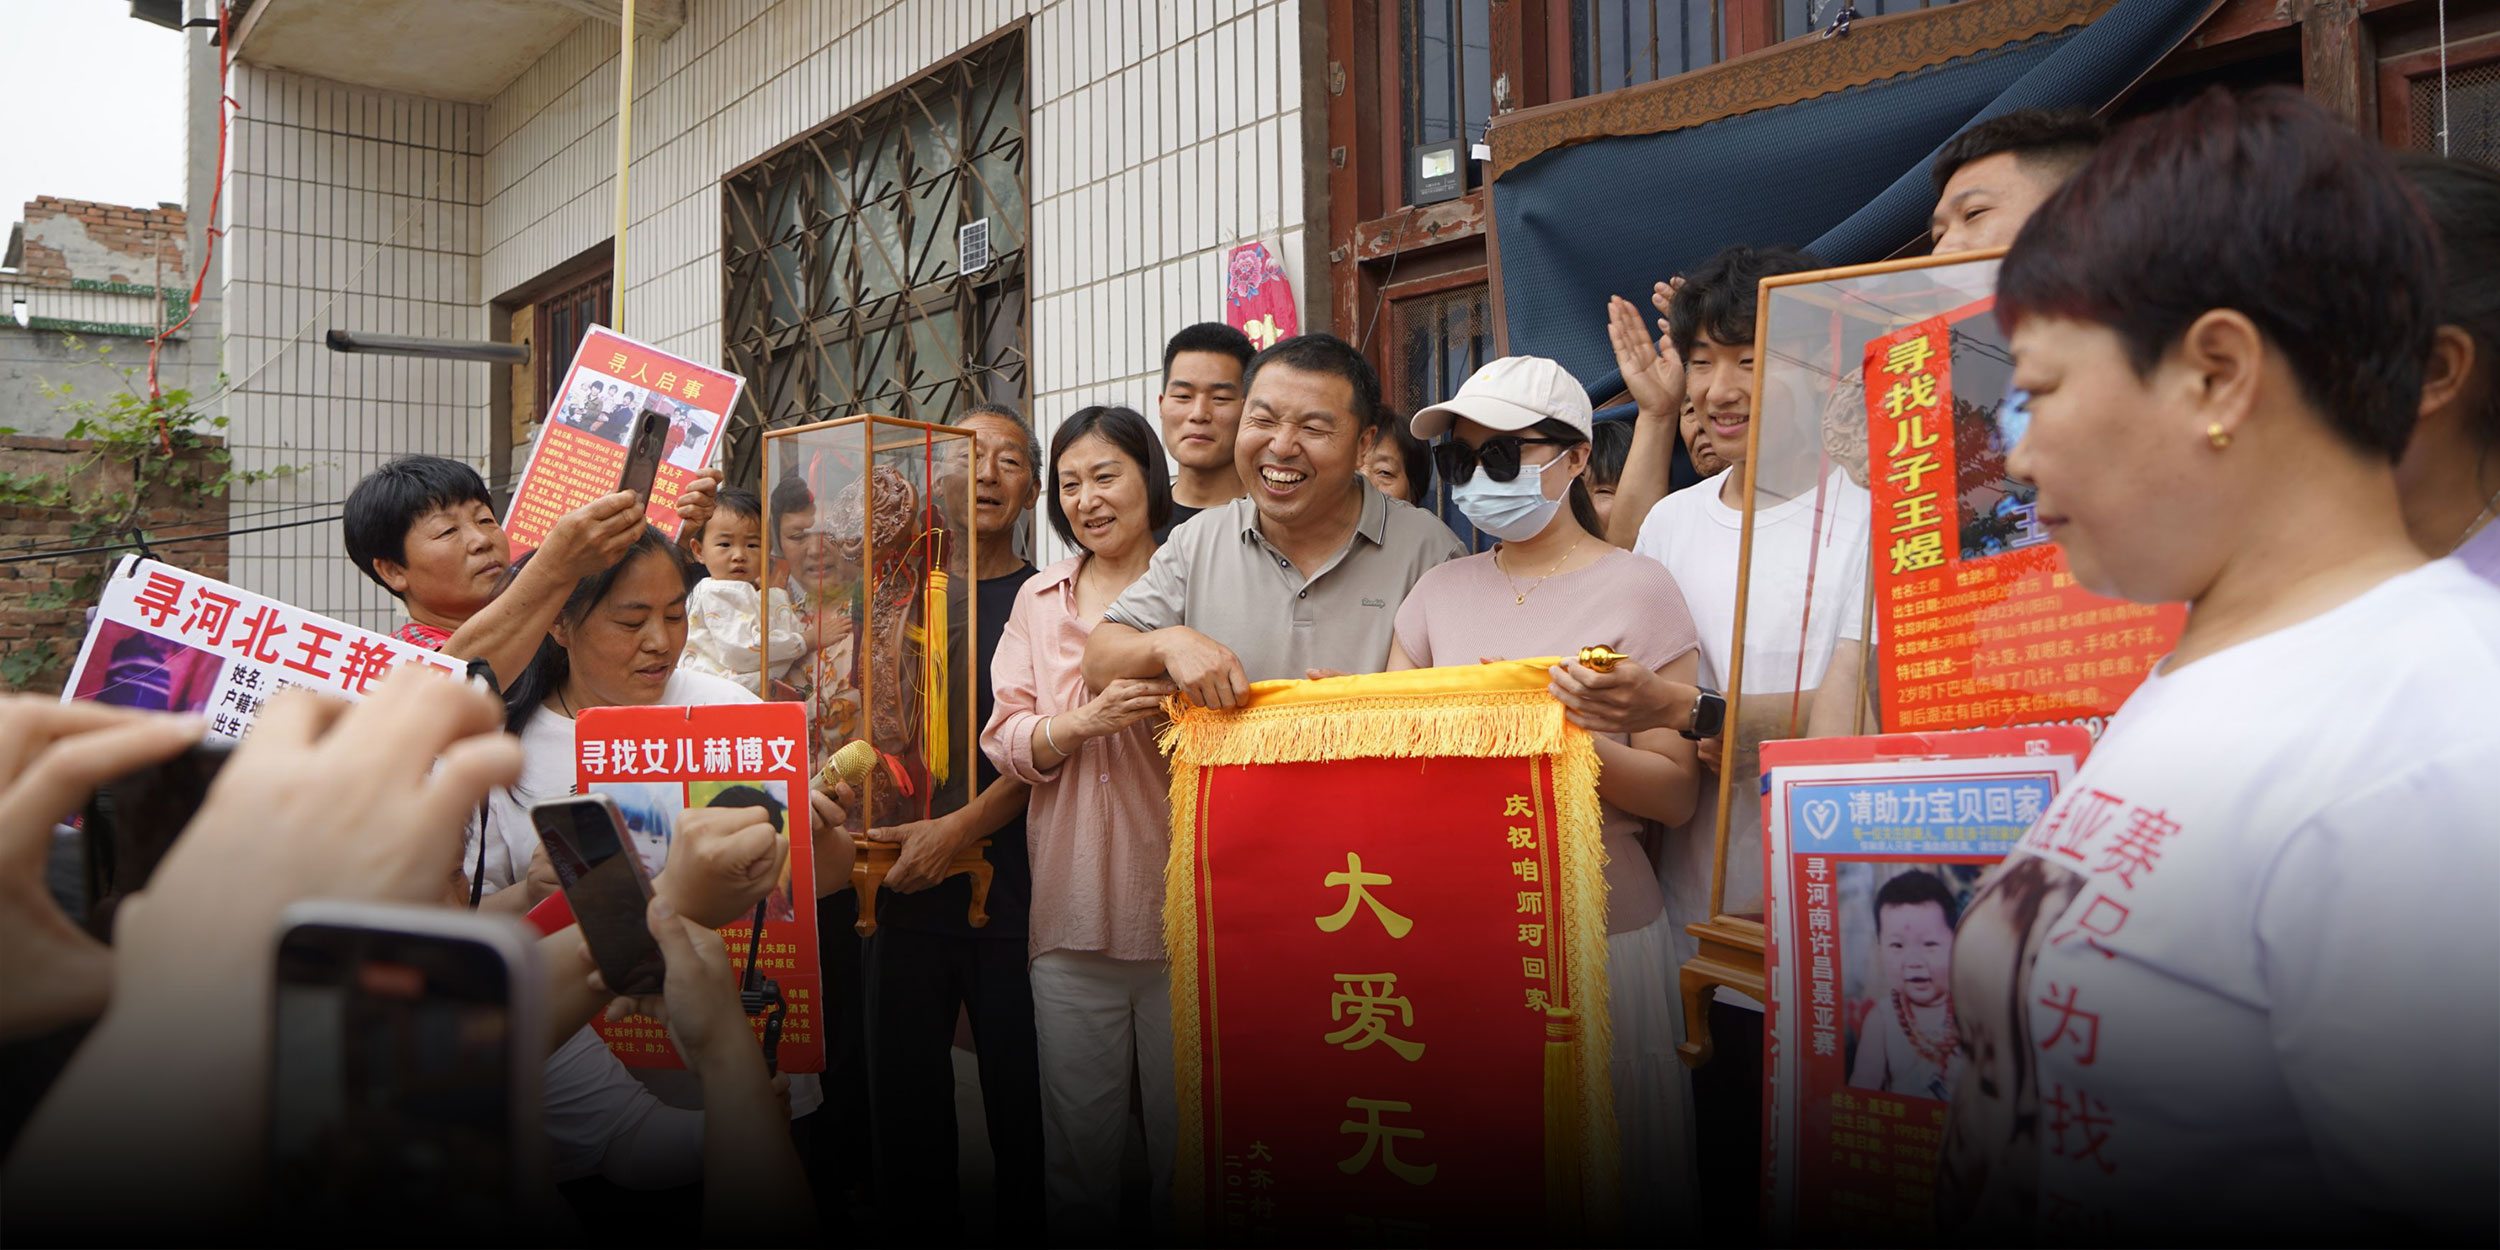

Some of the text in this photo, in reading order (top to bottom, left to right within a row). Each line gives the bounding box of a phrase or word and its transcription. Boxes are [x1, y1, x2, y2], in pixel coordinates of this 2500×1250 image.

[608, 352, 706, 400] 寻人启事
[1882, 334, 1947, 576] 寻找儿子王煜
[133, 571, 454, 695] 寻河北王艳
[582, 736, 797, 775] 寻找女儿赫博文
[1848, 784, 2043, 825] 请助力宝贝回家
[1503, 793, 1551, 1012] 庆祝咱师珂回家
[1805, 857, 1837, 1057] 寻河南许昌聂亚赛
